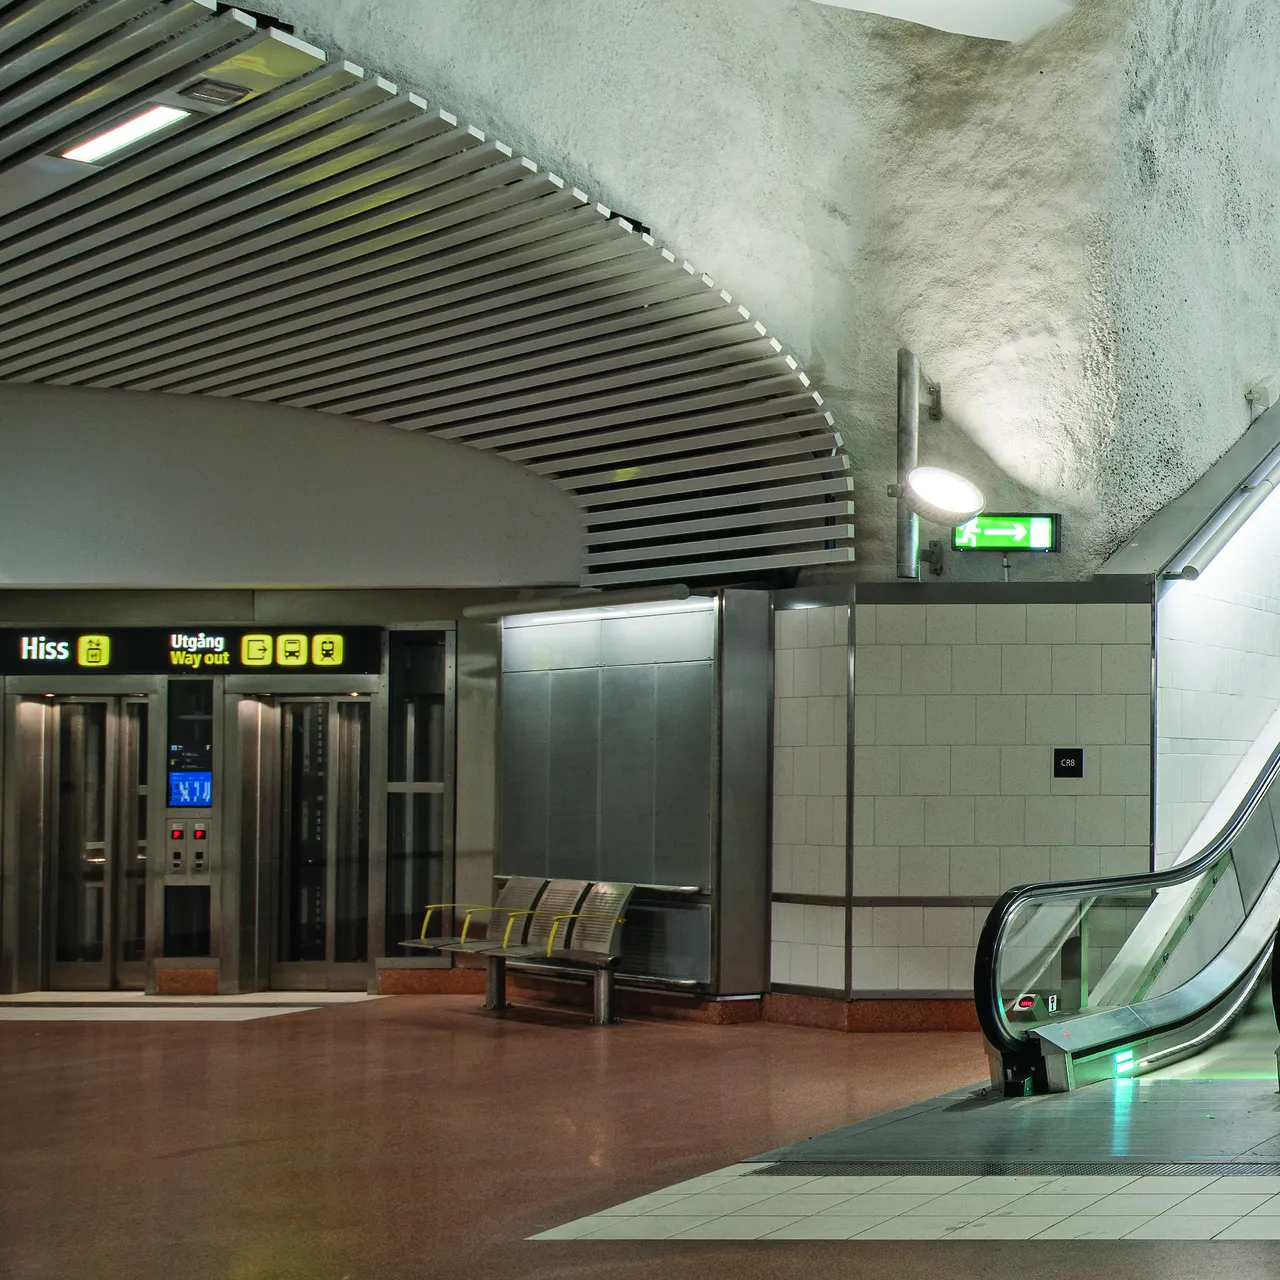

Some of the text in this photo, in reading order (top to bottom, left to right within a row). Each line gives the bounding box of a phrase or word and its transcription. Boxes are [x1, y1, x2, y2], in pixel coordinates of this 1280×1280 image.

[21, 636, 69, 659] Hiss
[170, 632, 224, 652] Utgång
[169, 651, 230, 668] Way out
[1060, 758, 1076, 767] CR8
